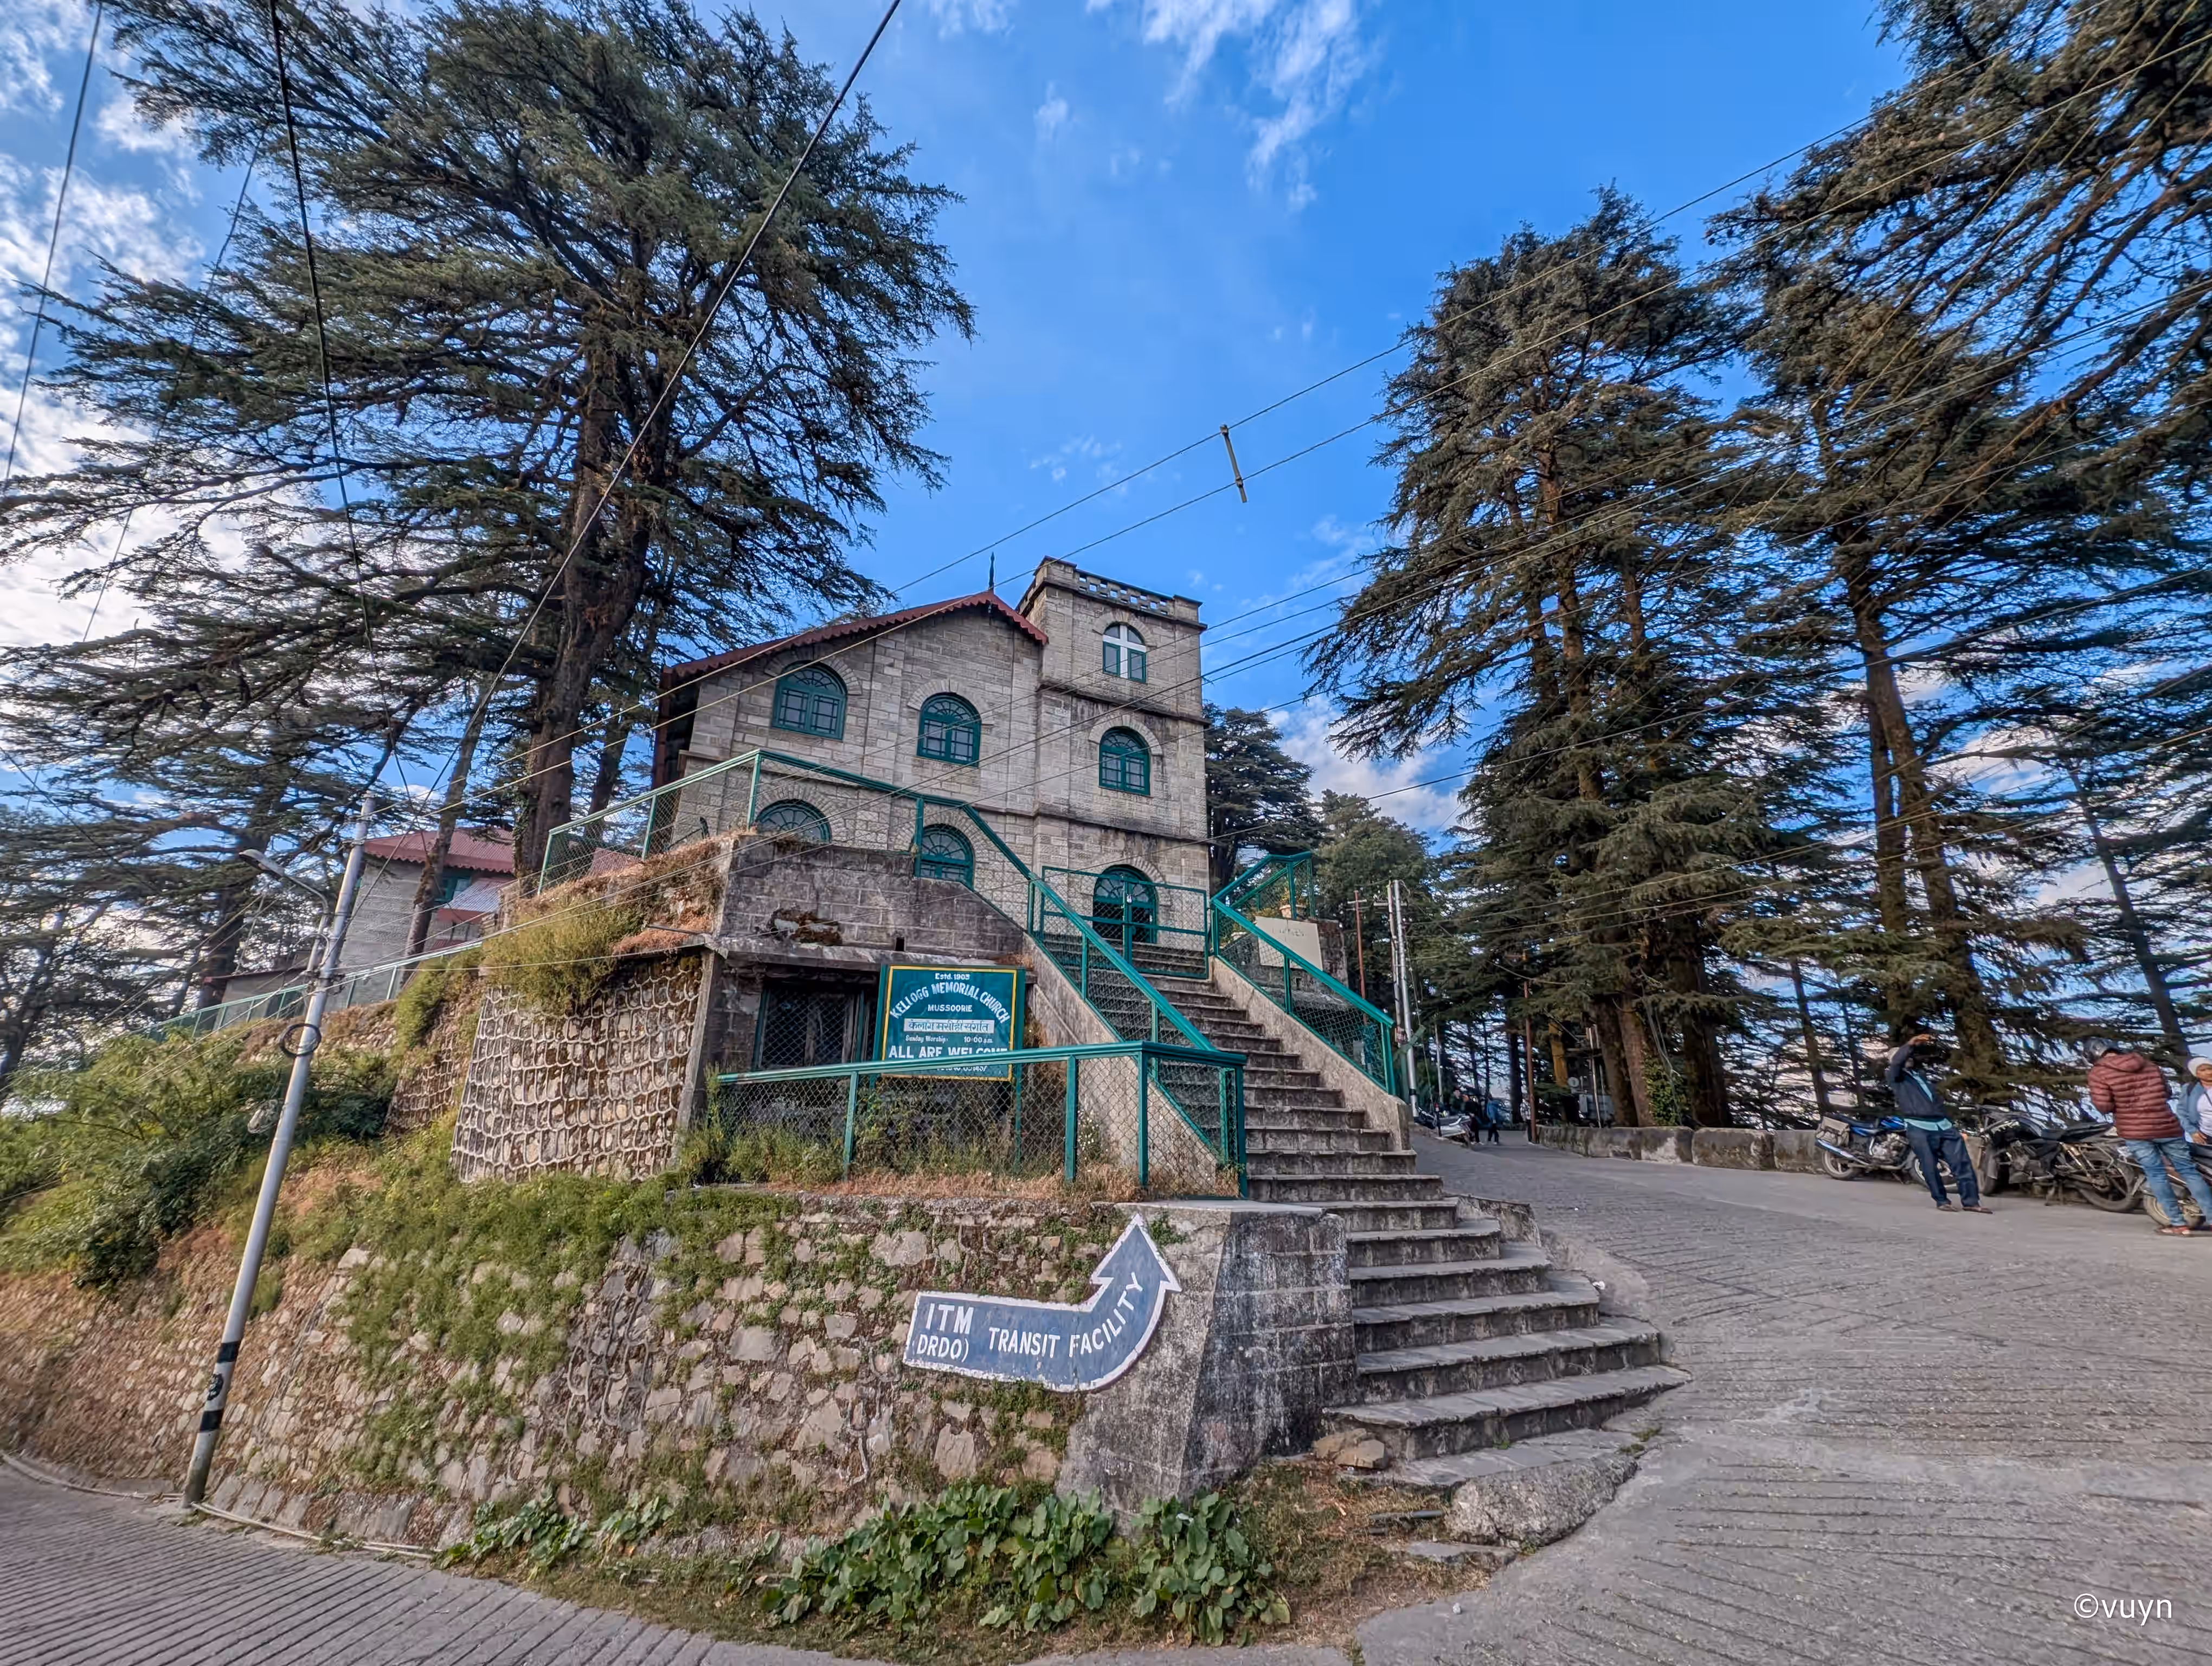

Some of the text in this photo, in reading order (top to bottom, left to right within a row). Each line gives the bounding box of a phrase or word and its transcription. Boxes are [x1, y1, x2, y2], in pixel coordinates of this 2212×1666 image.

[890, 982, 1011, 1024] KELLOGG MEMORIAL CHURCH
[927, 1004, 973, 1013] MUSSOORIE
[905, 1034, 924, 1043] Sunday
[889, 1045, 1008, 1059] ALL ARE WELC
[925, 1303, 974, 1335] ITM
[988, 1327, 1060, 1359] TRANSIT
[1068, 1271, 1143, 1358] FACILITY
